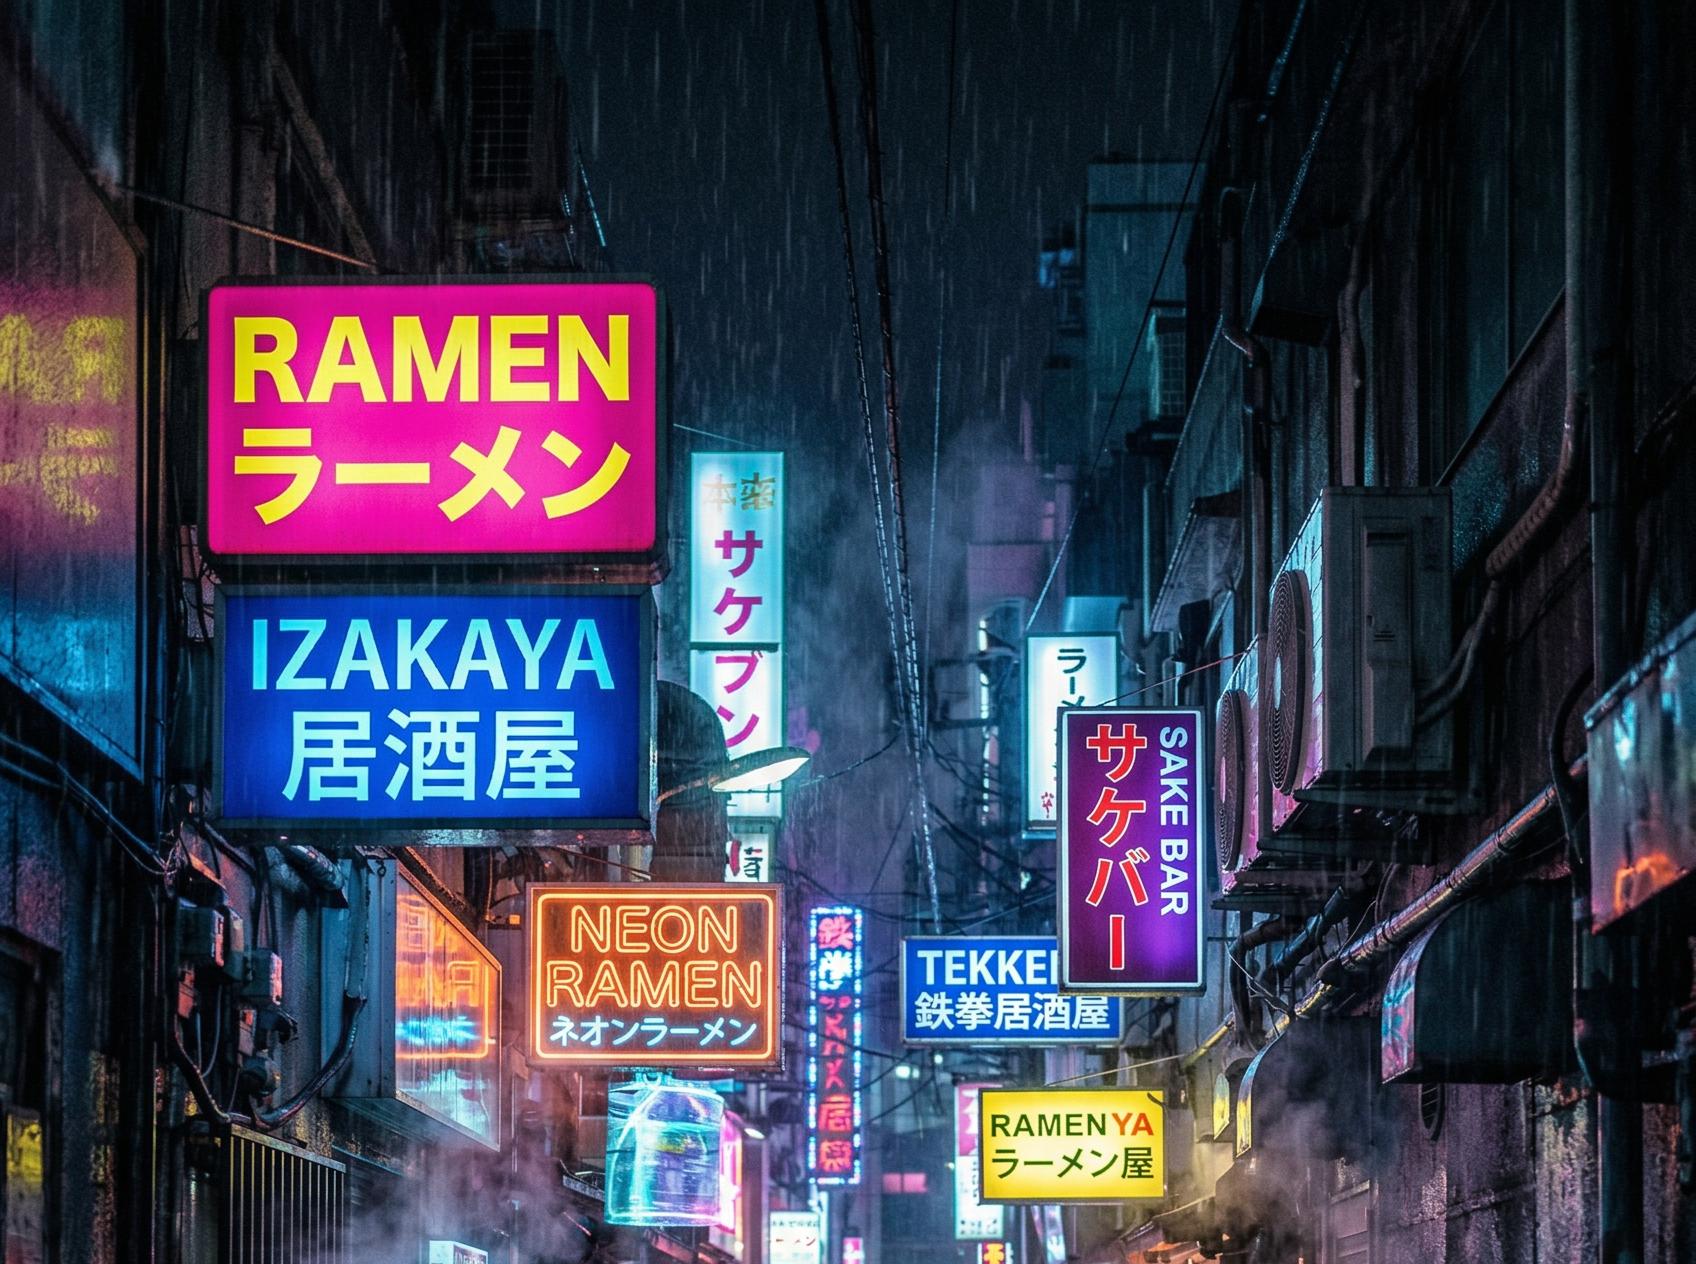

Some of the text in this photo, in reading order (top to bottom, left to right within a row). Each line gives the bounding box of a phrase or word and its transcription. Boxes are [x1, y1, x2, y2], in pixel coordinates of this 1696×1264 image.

[233, 314, 630, 404] RAMEN
[233, 424, 632, 526] ラーメン
[251, 618, 615, 691] IZAKAYA
[281, 708, 582, 802] 居酒屋
[1085, 723, 1150, 970] サケバー
[1159, 726, 1189, 916] SAKE BAR
[571, 905, 738, 954] NEON
[546, 959, 762, 1009] RAMEN
[917, 949, 1058, 985] TEKKE
[549, 1015, 758, 1047] ネオンラーメン
[914, 991, 1110, 1031] 鉄拳居酒屋
[991, 1147, 1155, 1180] ラーメン屋
